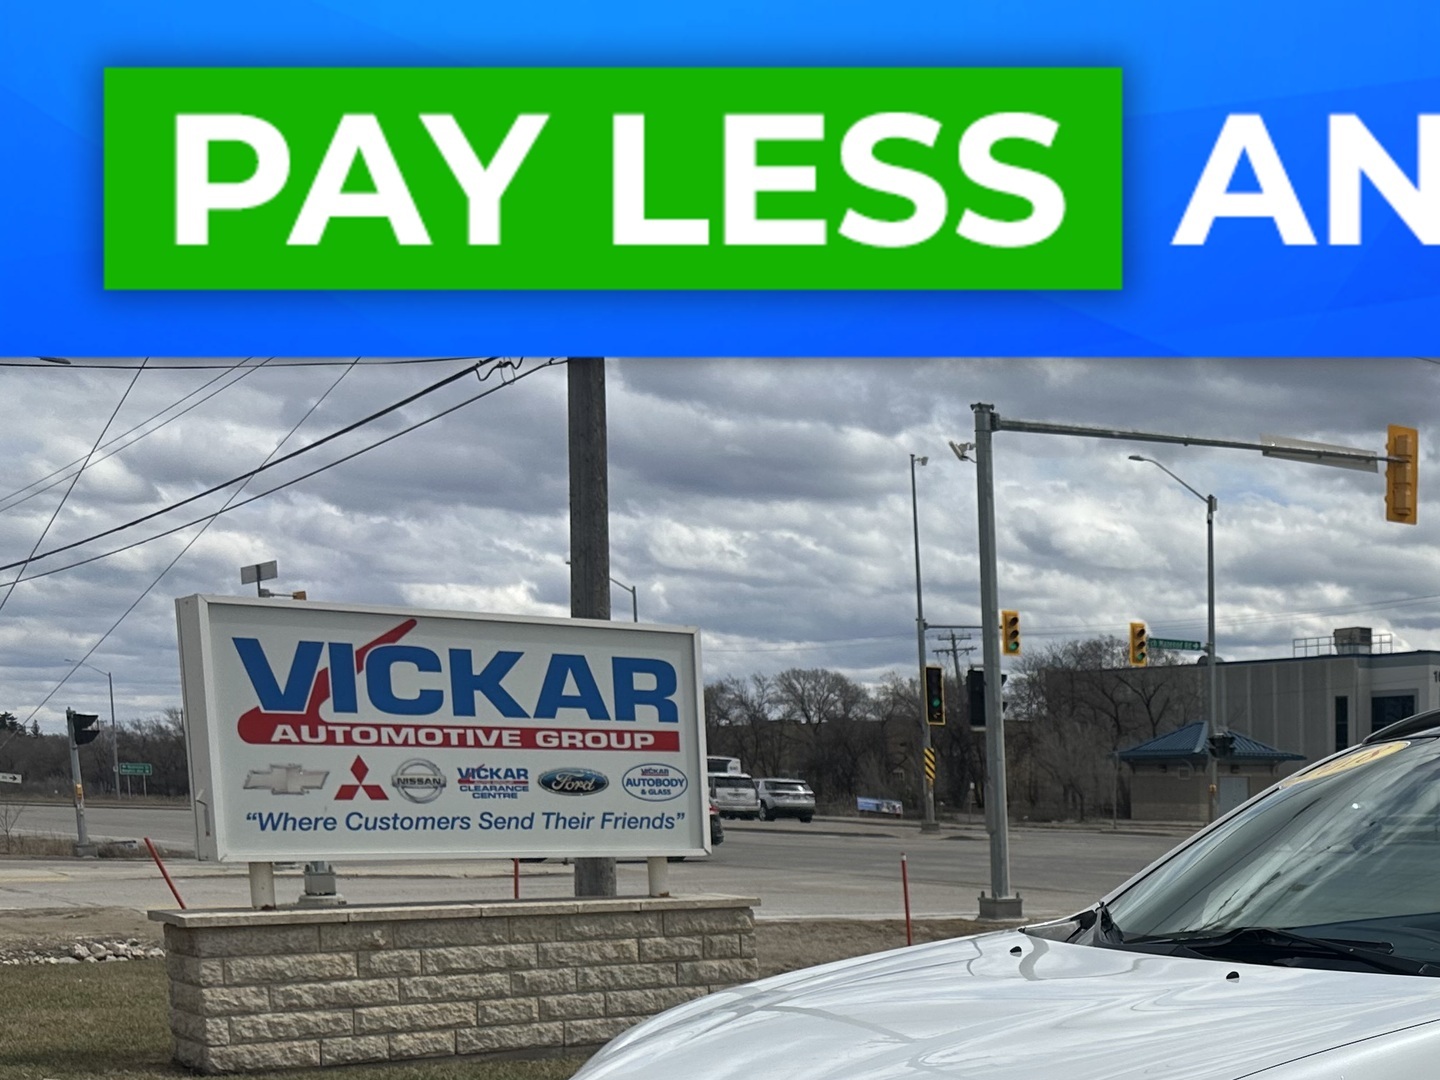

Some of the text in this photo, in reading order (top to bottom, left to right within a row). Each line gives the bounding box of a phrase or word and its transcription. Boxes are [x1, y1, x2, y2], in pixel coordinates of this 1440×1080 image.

[231, 637, 679, 723] VICKAR
[270, 723, 656, 751] AUTOMOTIVE GROUP
[397, 777, 442, 785] NISSAN
[457, 767, 529, 780] VICKAR
[551, 771, 597, 791] Ford
[625, 778, 685, 787] AUTOBODY
[246, 811, 686, 832] “Where Customers Send Their Friends”
